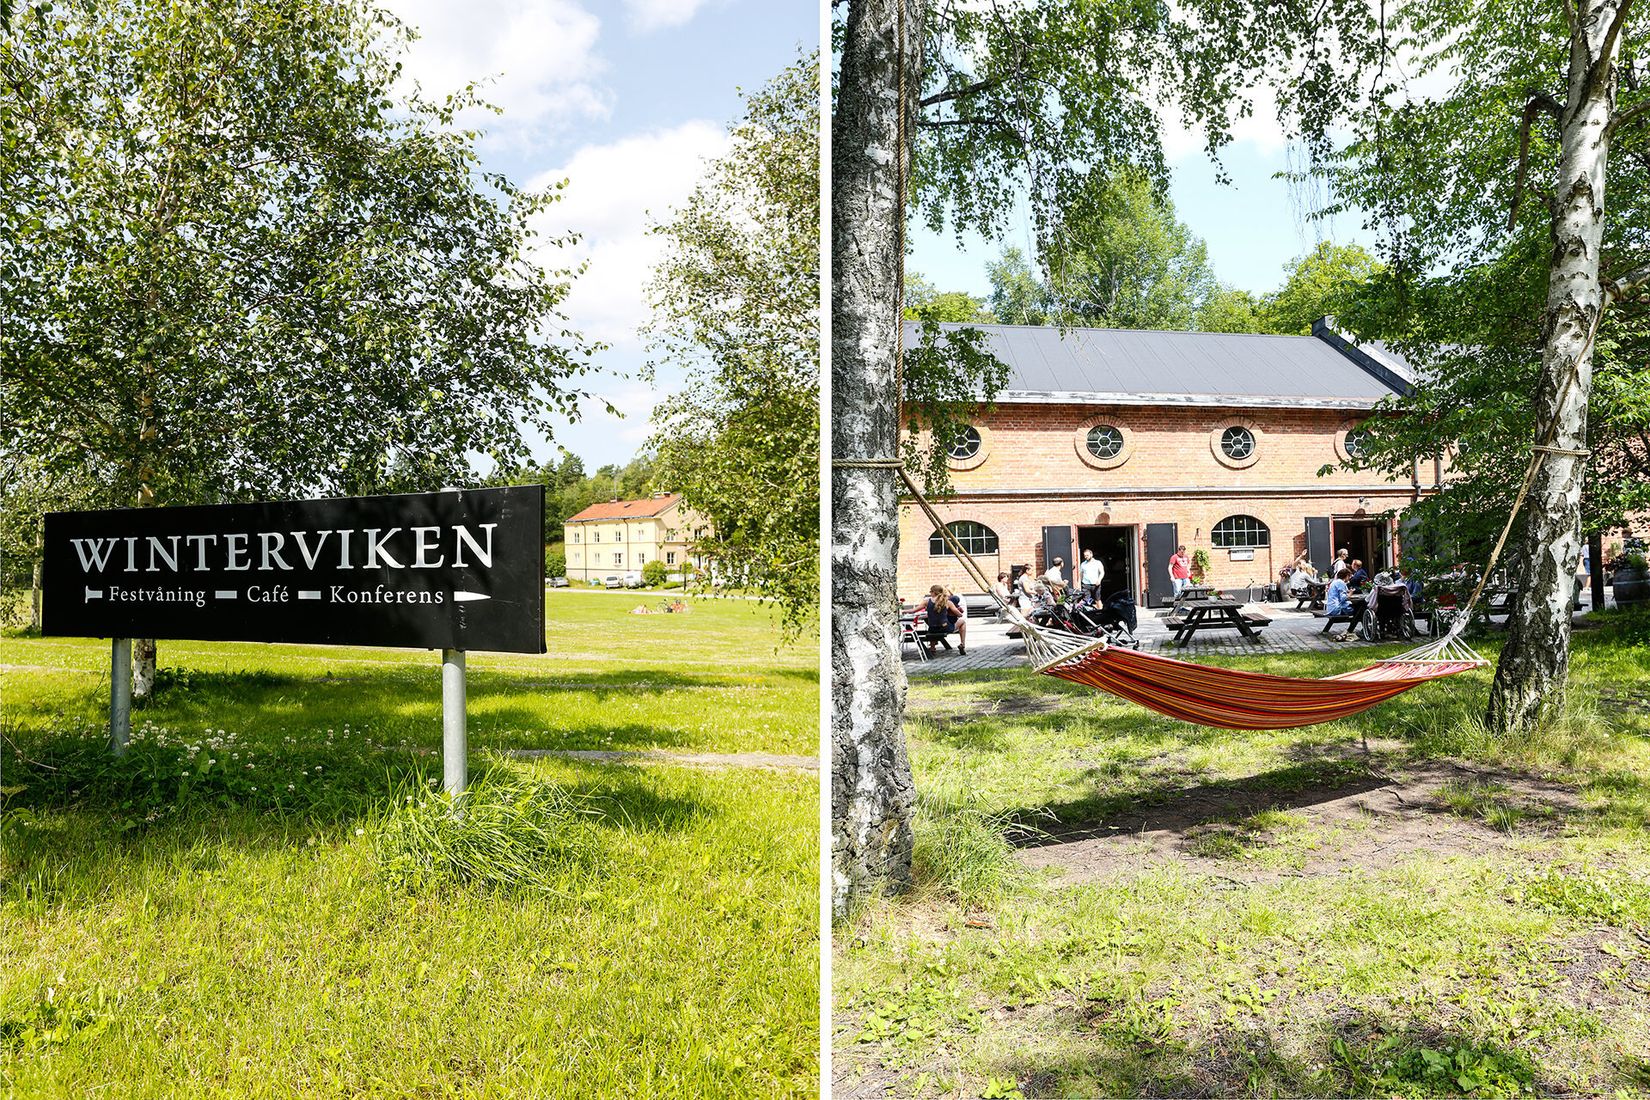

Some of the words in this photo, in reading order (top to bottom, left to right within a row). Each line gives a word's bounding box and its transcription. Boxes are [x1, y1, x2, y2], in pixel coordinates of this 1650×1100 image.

[69, 523, 498, 573] WINTERVIKEN
[108, 586, 206, 608] Festvåning
[246, 584, 290, 603] Café
[329, 584, 444, 604] Konferens
